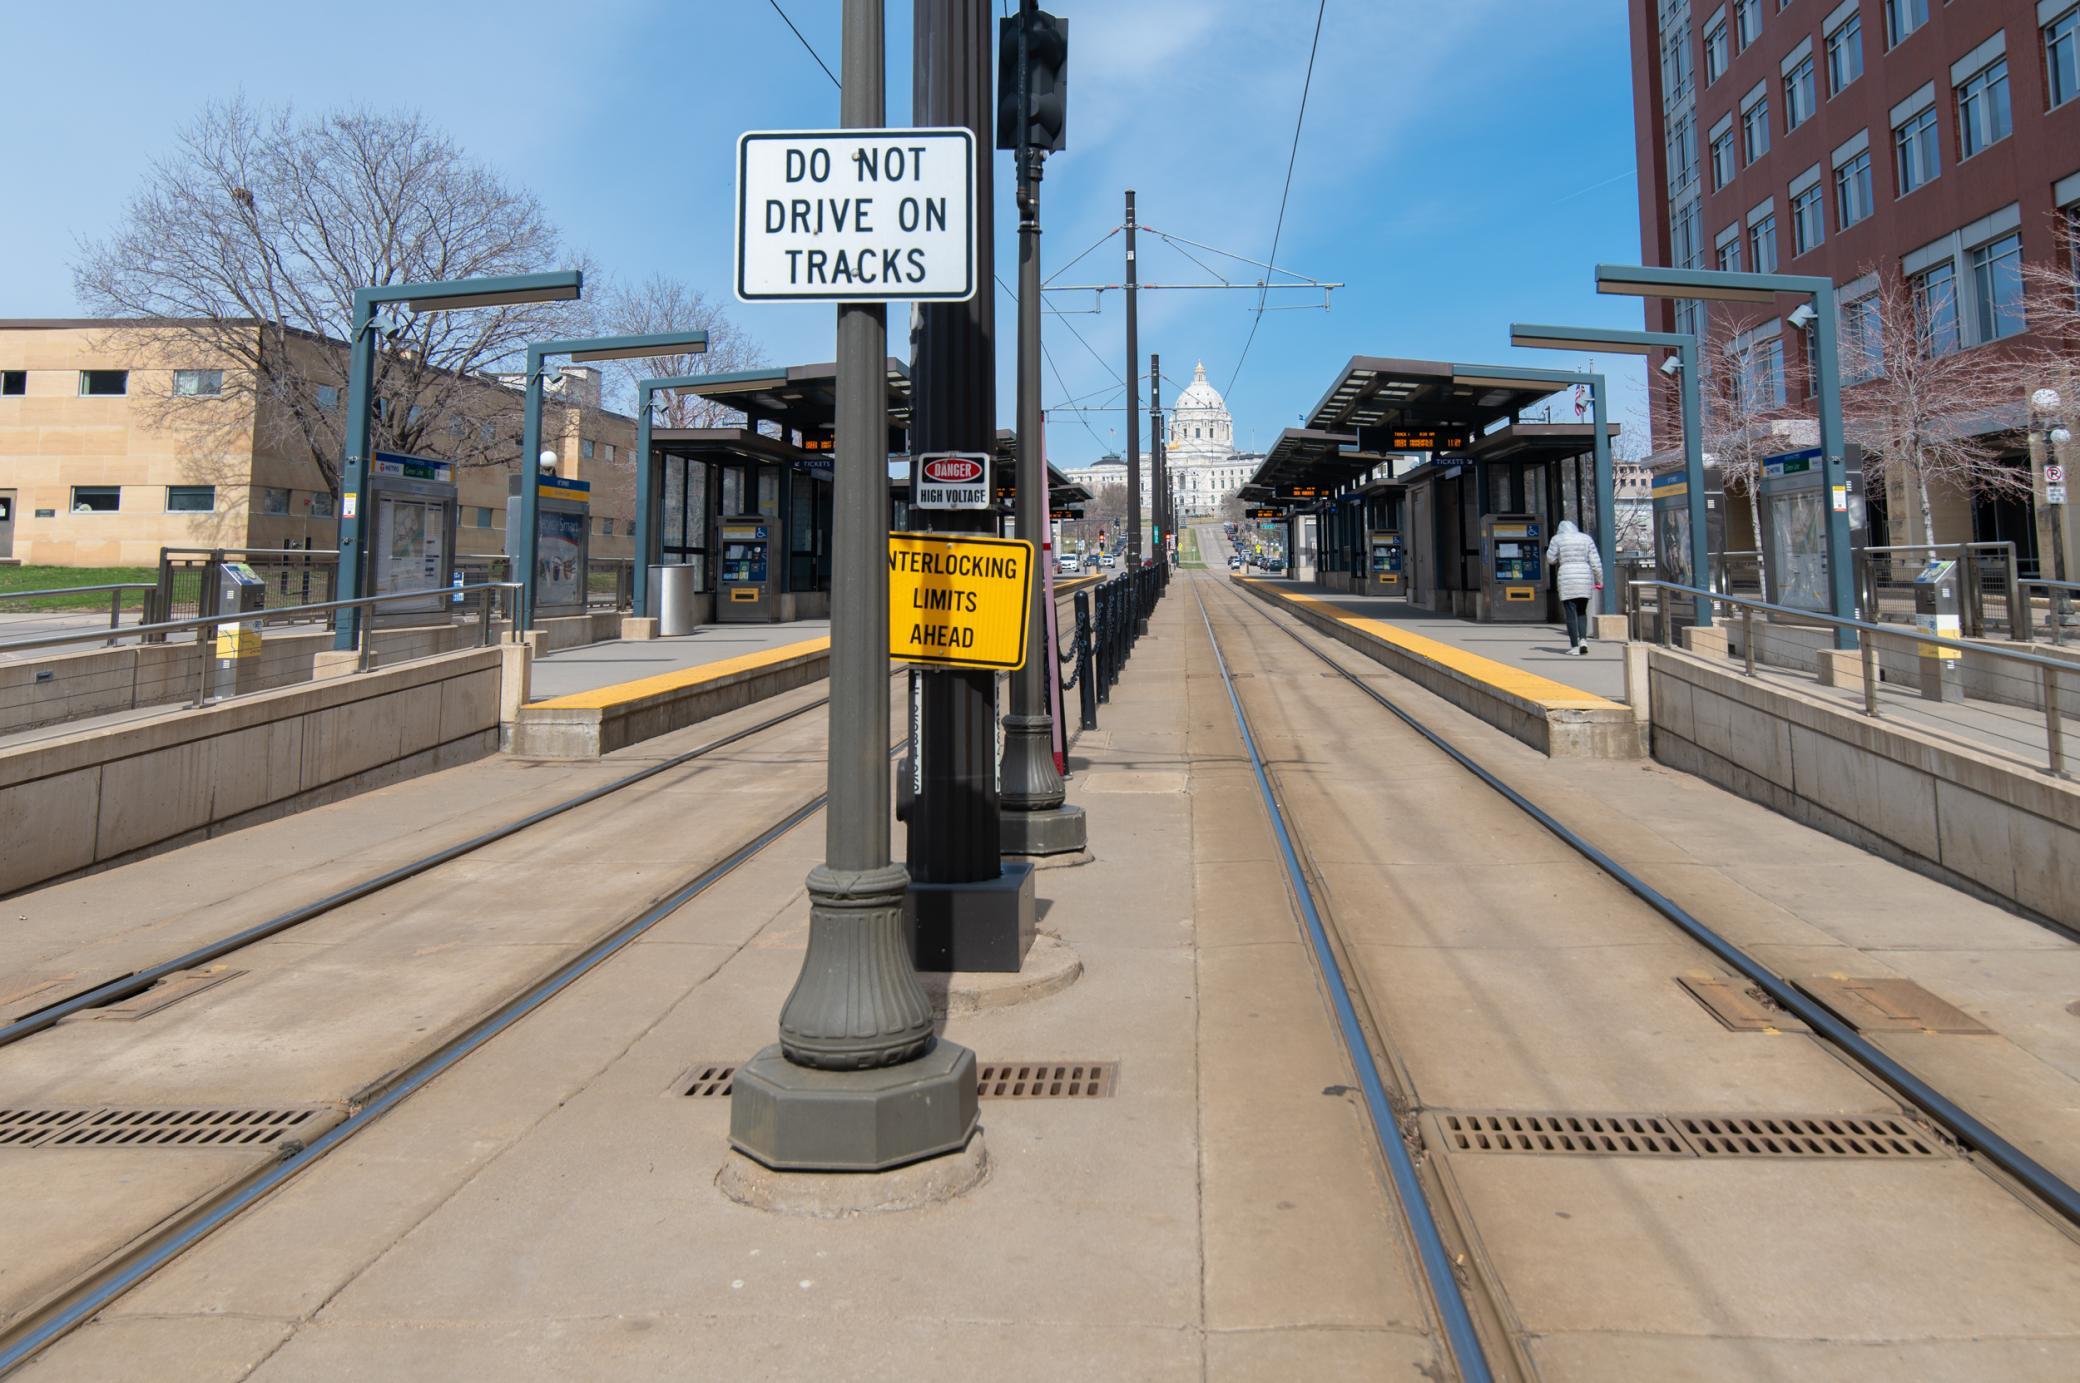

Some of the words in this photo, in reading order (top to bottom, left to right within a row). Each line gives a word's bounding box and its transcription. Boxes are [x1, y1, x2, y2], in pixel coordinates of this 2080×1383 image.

[786, 148, 830, 183] DO
[857, 147, 926, 182] NOT
[765, 198, 873, 234] DRIVE
[898, 197, 946, 232] ON
[785, 248, 926, 284] TRACKS
[934, 463, 972, 477] DANGER
[920, 489, 943, 503] HIGH
[946, 489, 986, 503] VOLTAGE
[913, 587, 977, 612] LIMITS
[910, 624, 974, 648] AHEAD
